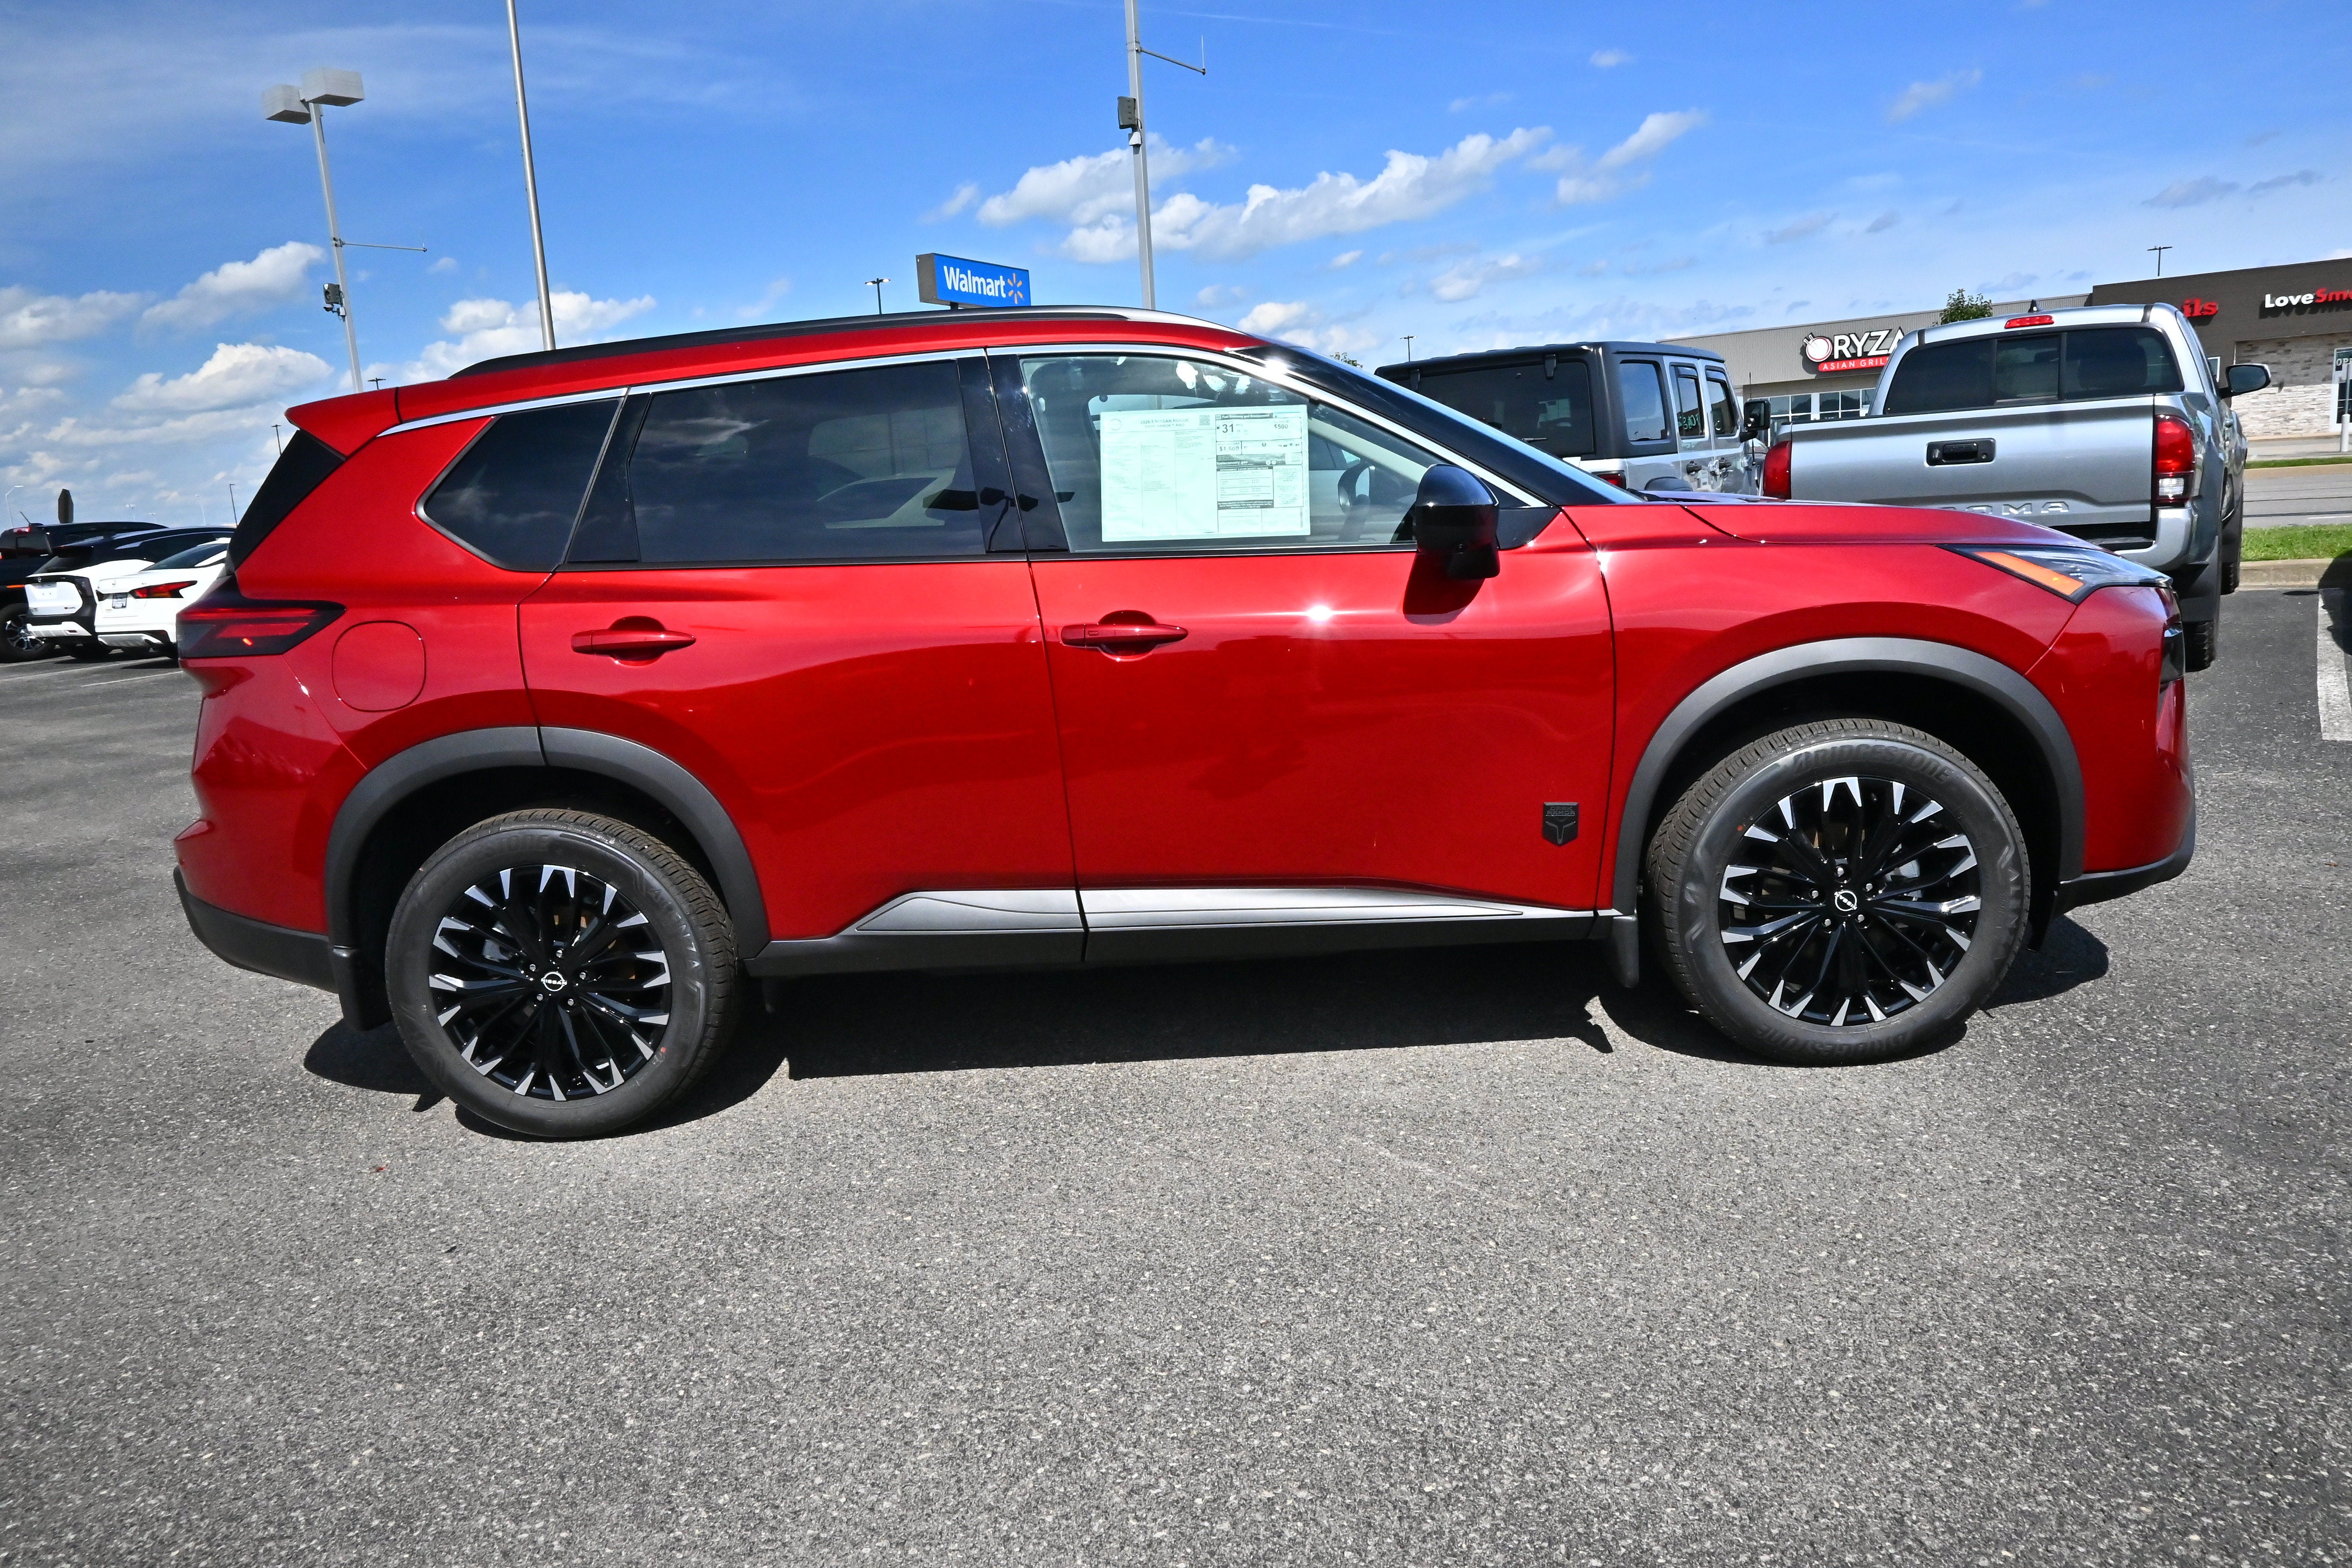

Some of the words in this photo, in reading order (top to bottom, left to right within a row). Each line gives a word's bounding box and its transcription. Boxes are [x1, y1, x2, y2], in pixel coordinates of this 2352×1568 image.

[943, 265, 1006, 298] Walmart
[1822, 361, 1855, 370] ASIAN
[1222, 423, 1233, 433] 31
[541, 977, 567, 985] NISSAN
